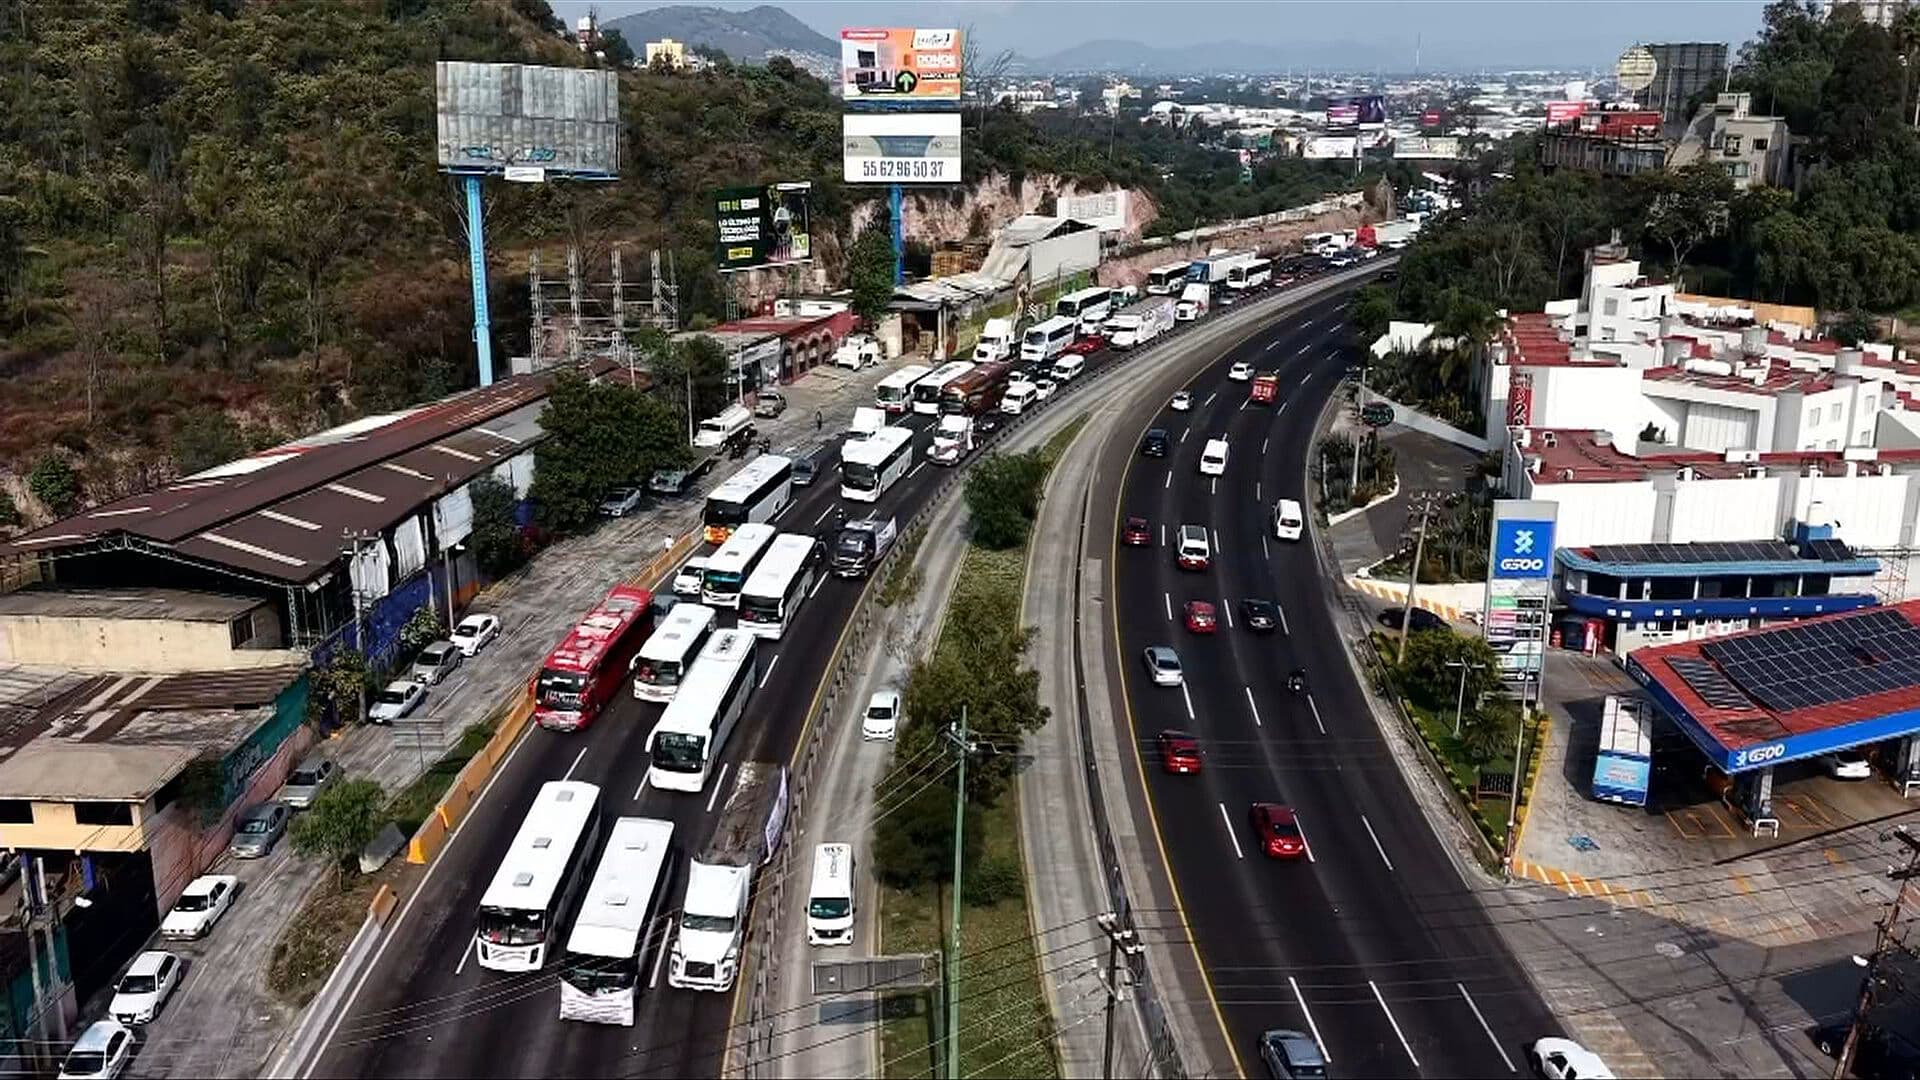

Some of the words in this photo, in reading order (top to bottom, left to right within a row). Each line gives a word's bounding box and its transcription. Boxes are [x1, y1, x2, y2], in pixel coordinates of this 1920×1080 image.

[863, 161, 877, 177] 55
[880, 161, 894, 177] 62
[896, 161, 911, 177] 96
[913, 161, 928, 178] 50
[930, 161, 944, 177] 37
[1500, 558, 1544, 571] G500
[1749, 743, 1786, 763] G500
